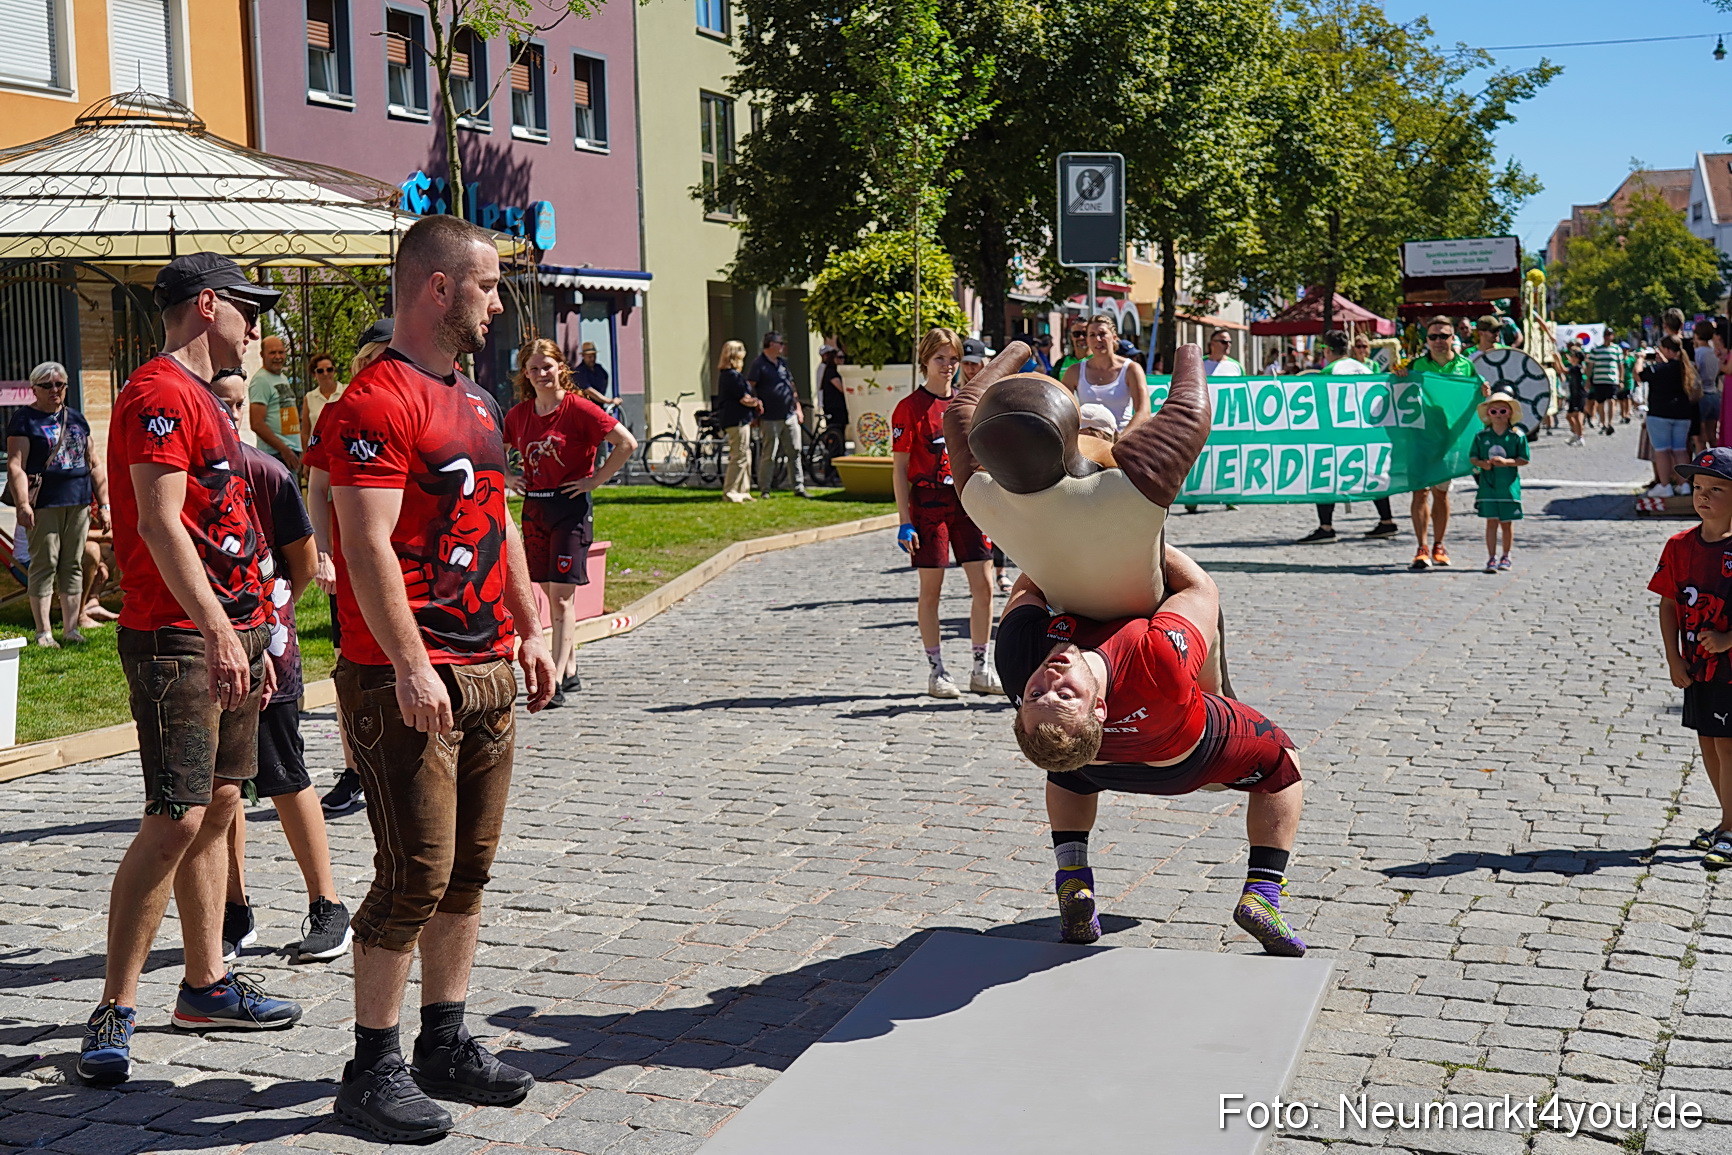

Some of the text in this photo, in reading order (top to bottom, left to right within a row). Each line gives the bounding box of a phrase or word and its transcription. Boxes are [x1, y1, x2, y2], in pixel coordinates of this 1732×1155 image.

[1080, 203, 1103, 211] ZONE
[1150, 384, 1423, 427] SMOS LOS
[147, 416, 175, 436] ASV
[349, 439, 379, 461] ASV
[1185, 446, 1391, 492] VERDES!
